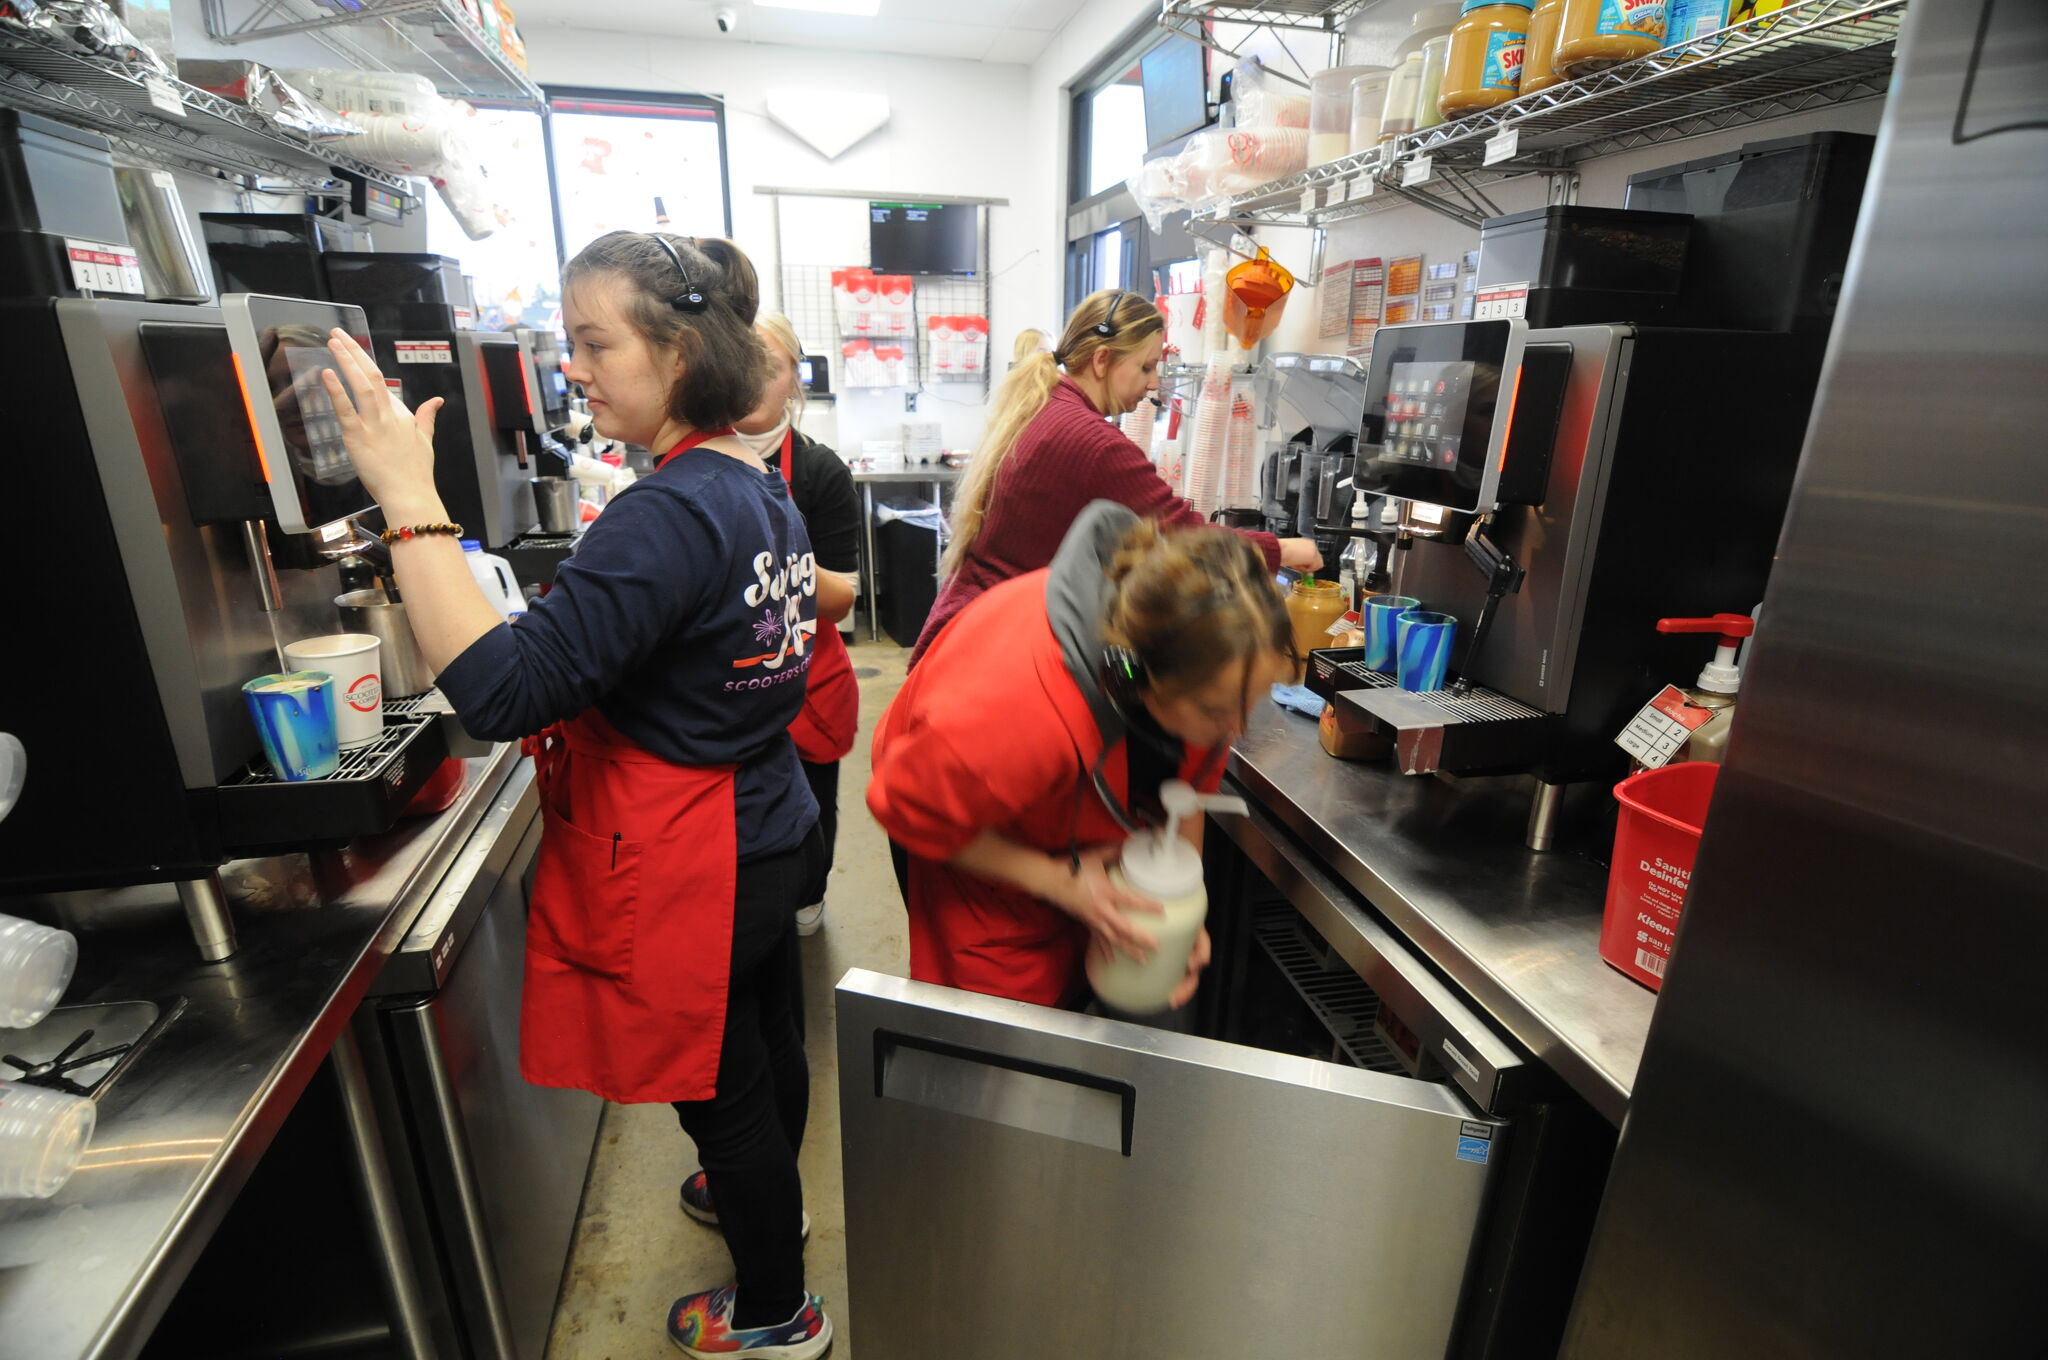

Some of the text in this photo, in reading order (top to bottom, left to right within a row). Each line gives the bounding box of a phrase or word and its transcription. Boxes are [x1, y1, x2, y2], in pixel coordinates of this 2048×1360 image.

[83, 269, 91, 283] 2
[106, 271, 113, 285] 3
[1481, 303, 1519, 315] 2 3 3
[1649, 713, 1682, 737] Small 2
[1626, 738, 1640, 750] Large
[1635, 723, 1670, 750] Medium 3
